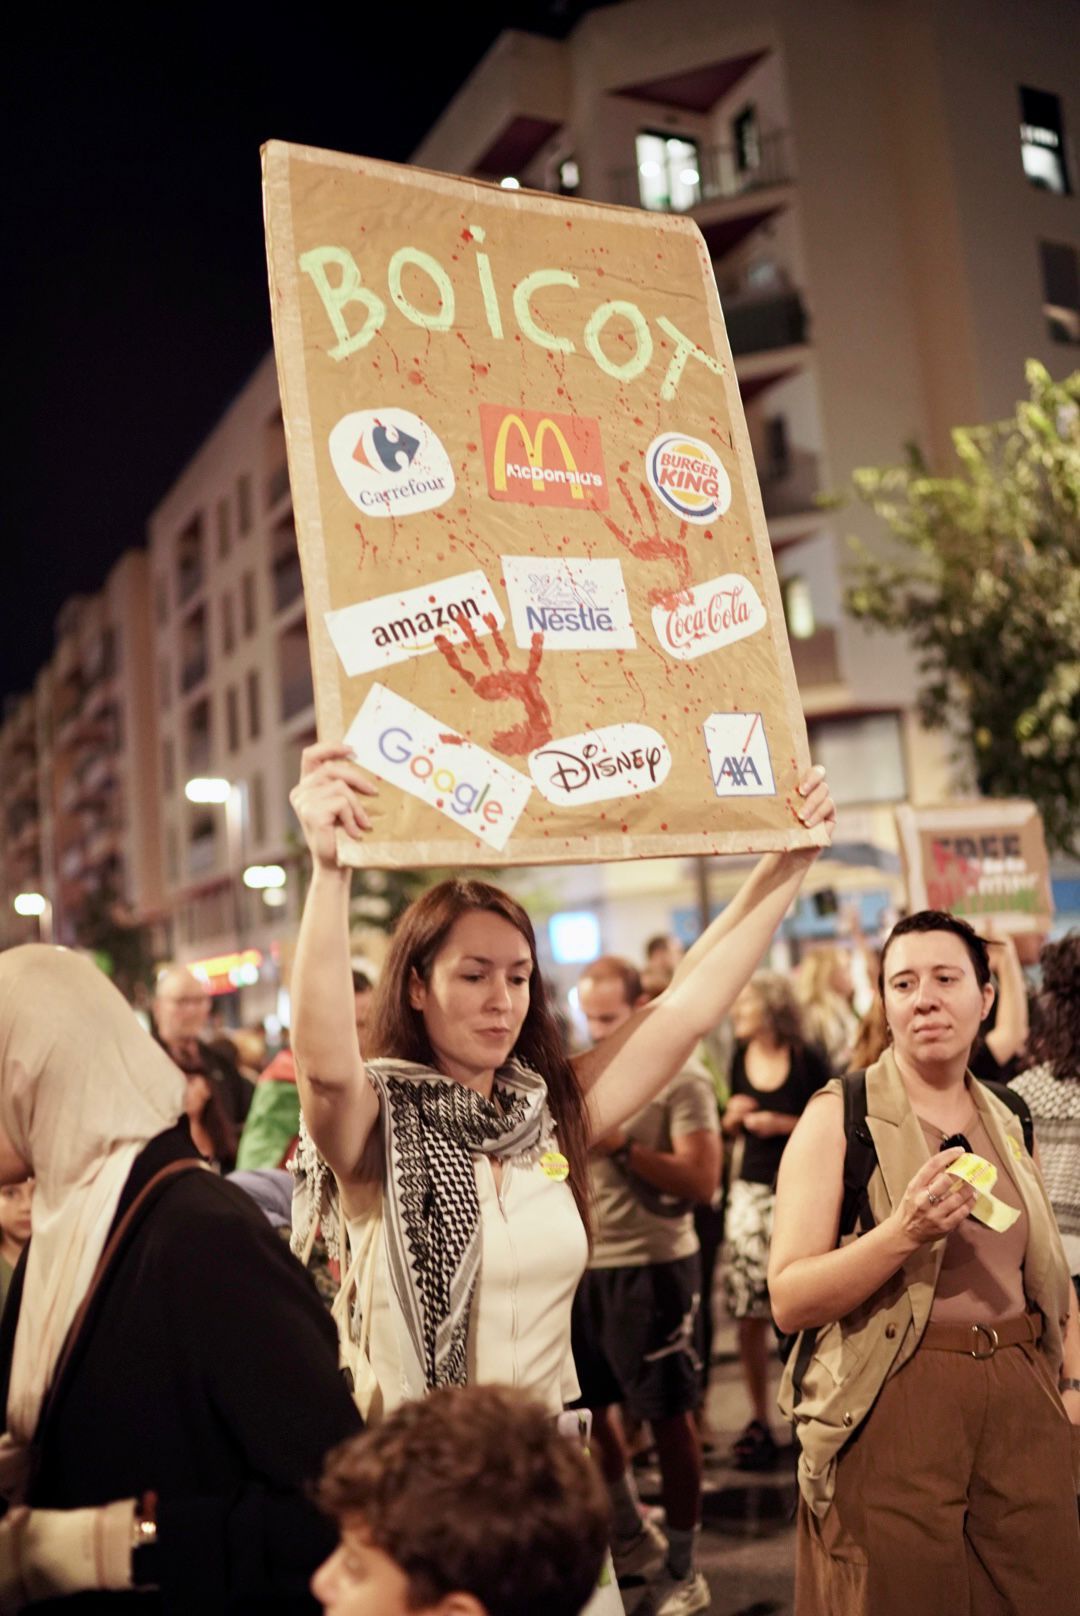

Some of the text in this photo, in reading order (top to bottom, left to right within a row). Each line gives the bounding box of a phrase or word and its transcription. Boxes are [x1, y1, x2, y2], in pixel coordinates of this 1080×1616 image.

[506, 463, 603, 487] McDonald's
[660, 453, 718, 480] BURGER
[359, 477, 445, 506] Carrefour
[659, 467, 719, 497] KING
[371, 598, 481, 647] amazon
[378, 727, 504, 824] Google
[714, 756, 763, 787] AXA
